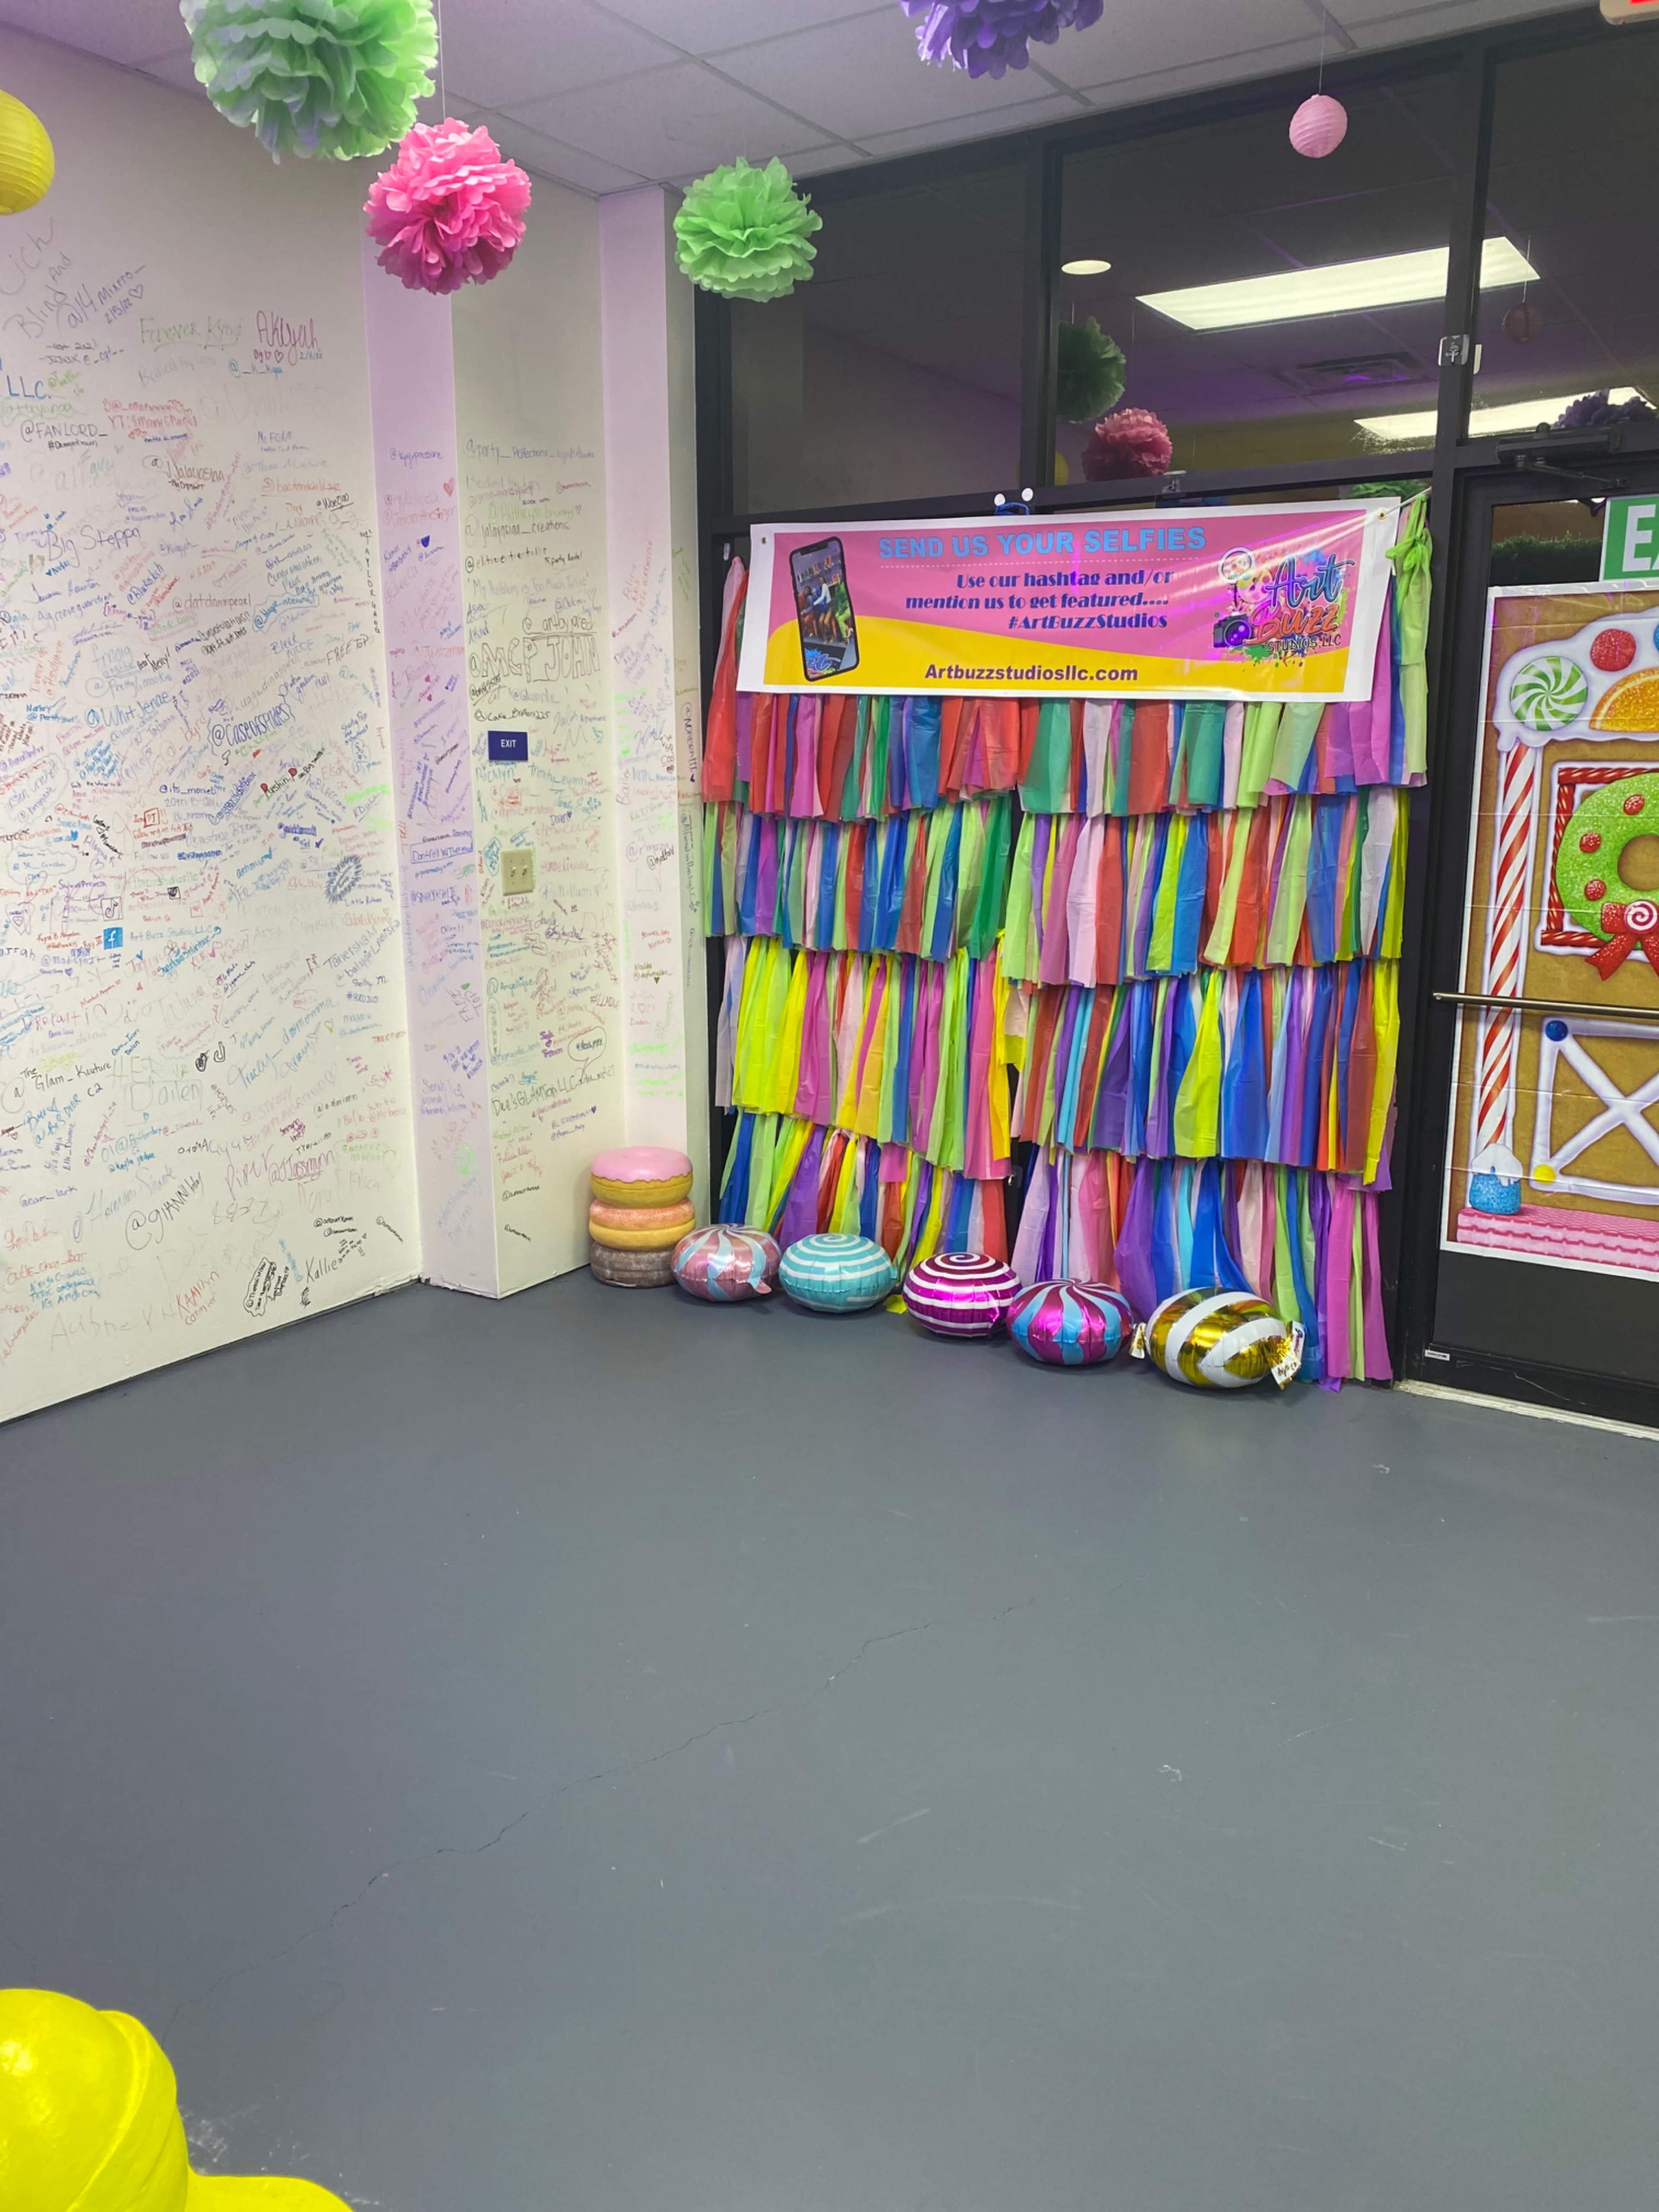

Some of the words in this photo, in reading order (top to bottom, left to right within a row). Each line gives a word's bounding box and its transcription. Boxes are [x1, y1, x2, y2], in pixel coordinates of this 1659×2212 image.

[879, 537, 943, 559] SEND
[952, 535, 988, 556] US
[997, 531, 1074, 555] YOUR
[1083, 526, 1206, 553] SELFIES
[1622, 504, 1659, 573] E
[957, 574, 985, 588] Use
[990, 575, 1020, 588] our
[1023, 570, 1100, 587] hashtag
[1105, 569, 1174, 585] and/or
[1264, 553, 1356, 609] Art
[906, 595, 980, 609] mention
[984, 596, 1004, 610] us
[1008, 596, 1025, 609] to
[1029, 595, 1057, 610] get
[1061, 592, 1169, 608] featured....
[1007, 613, 1168, 630] #ArtBuzzStudios
[1243, 601, 1340, 645] Buzz
[925, 664, 1138, 682] Artbuzzstudiosllc.com
[501, 739, 516, 748] EXIT
